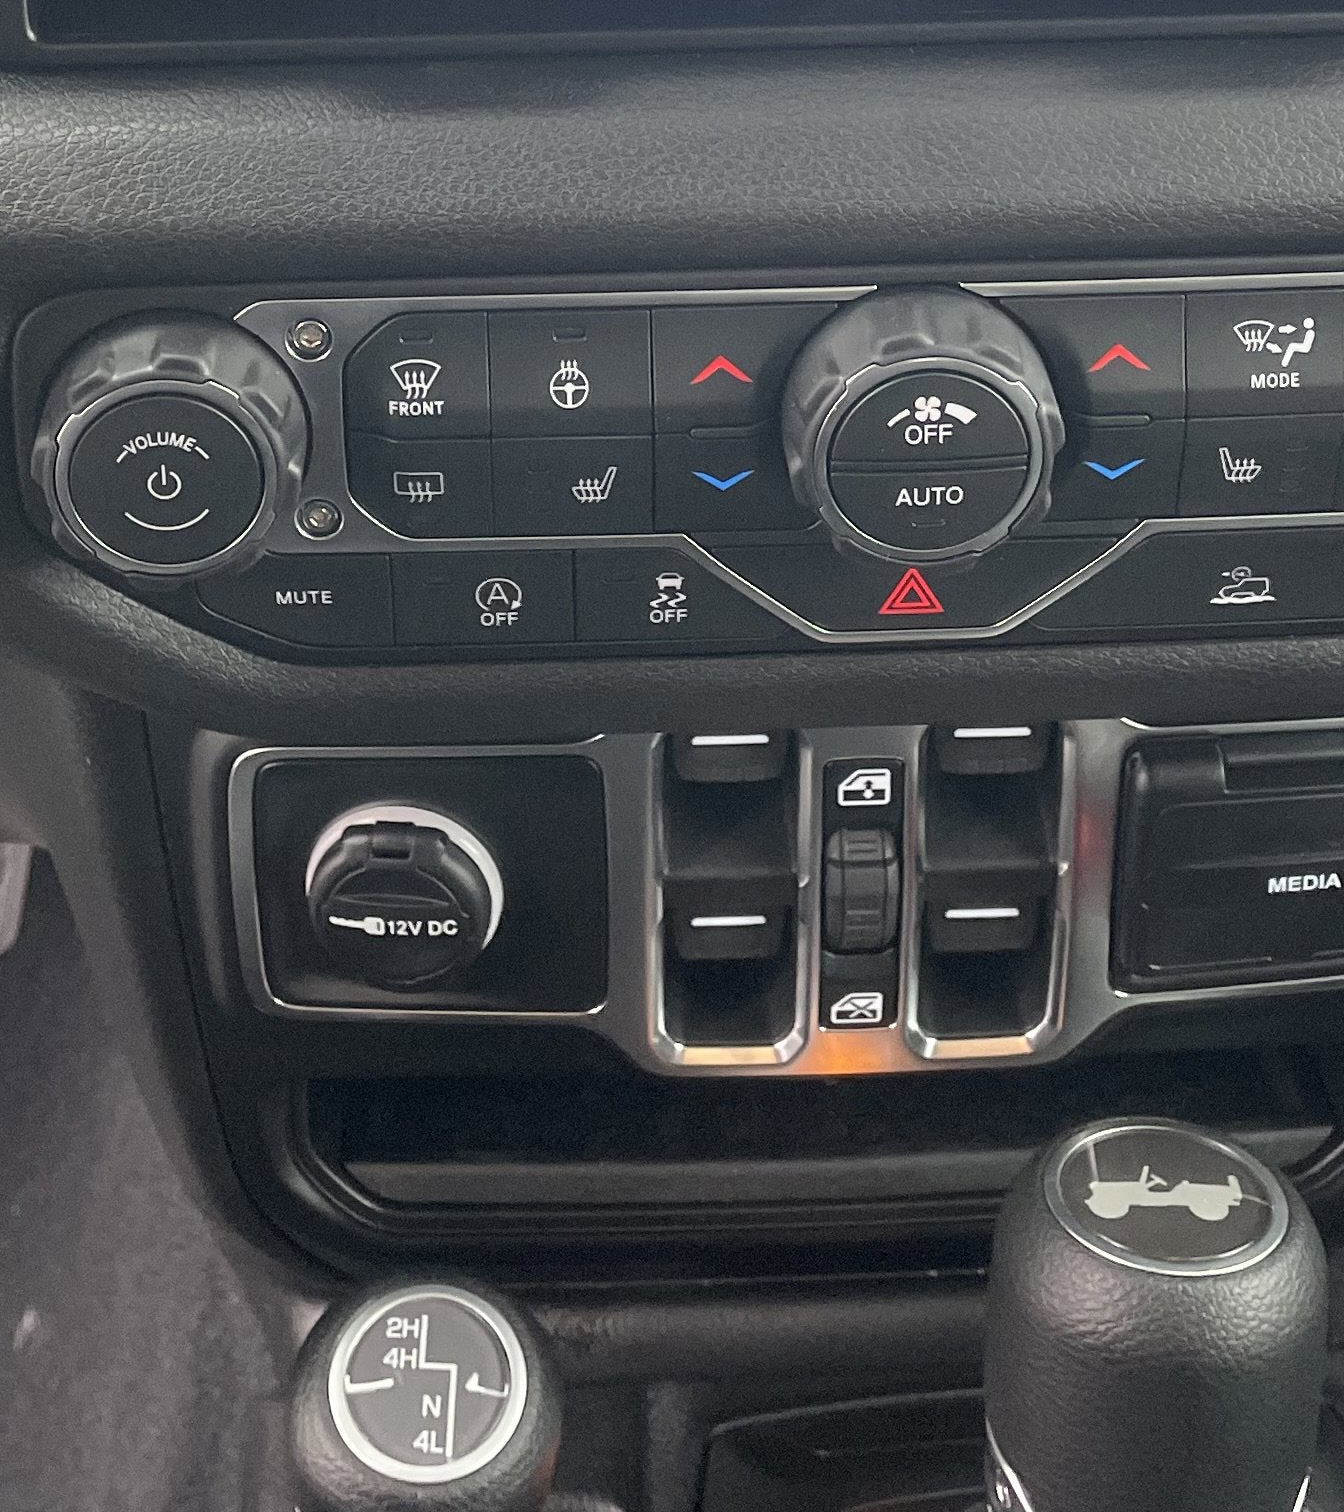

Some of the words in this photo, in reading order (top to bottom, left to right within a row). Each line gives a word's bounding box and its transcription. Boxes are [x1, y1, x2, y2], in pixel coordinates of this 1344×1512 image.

[1249, 372, 1301, 390] MODE
[388, 397, 445, 417] FRONT
[122, 431, 197, 455] VOLUME
[904, 423, 954, 445] OFF
[895, 484, 964, 507] AUTO
[275, 590, 333, 605] MUTE
[480, 609, 519, 627] OFF
[649, 605, 688, 624] OFF
[1267, 872, 1342, 895] MEDIA
[386, 920, 422, 935] 12V
[427, 920, 458, 936] DC
[386, 1317, 420, 1338] 2H
[383, 1348, 418, 1370] 4H
[422, 1394, 442, 1418] N
[412, 1430, 444, 1454] 4L
